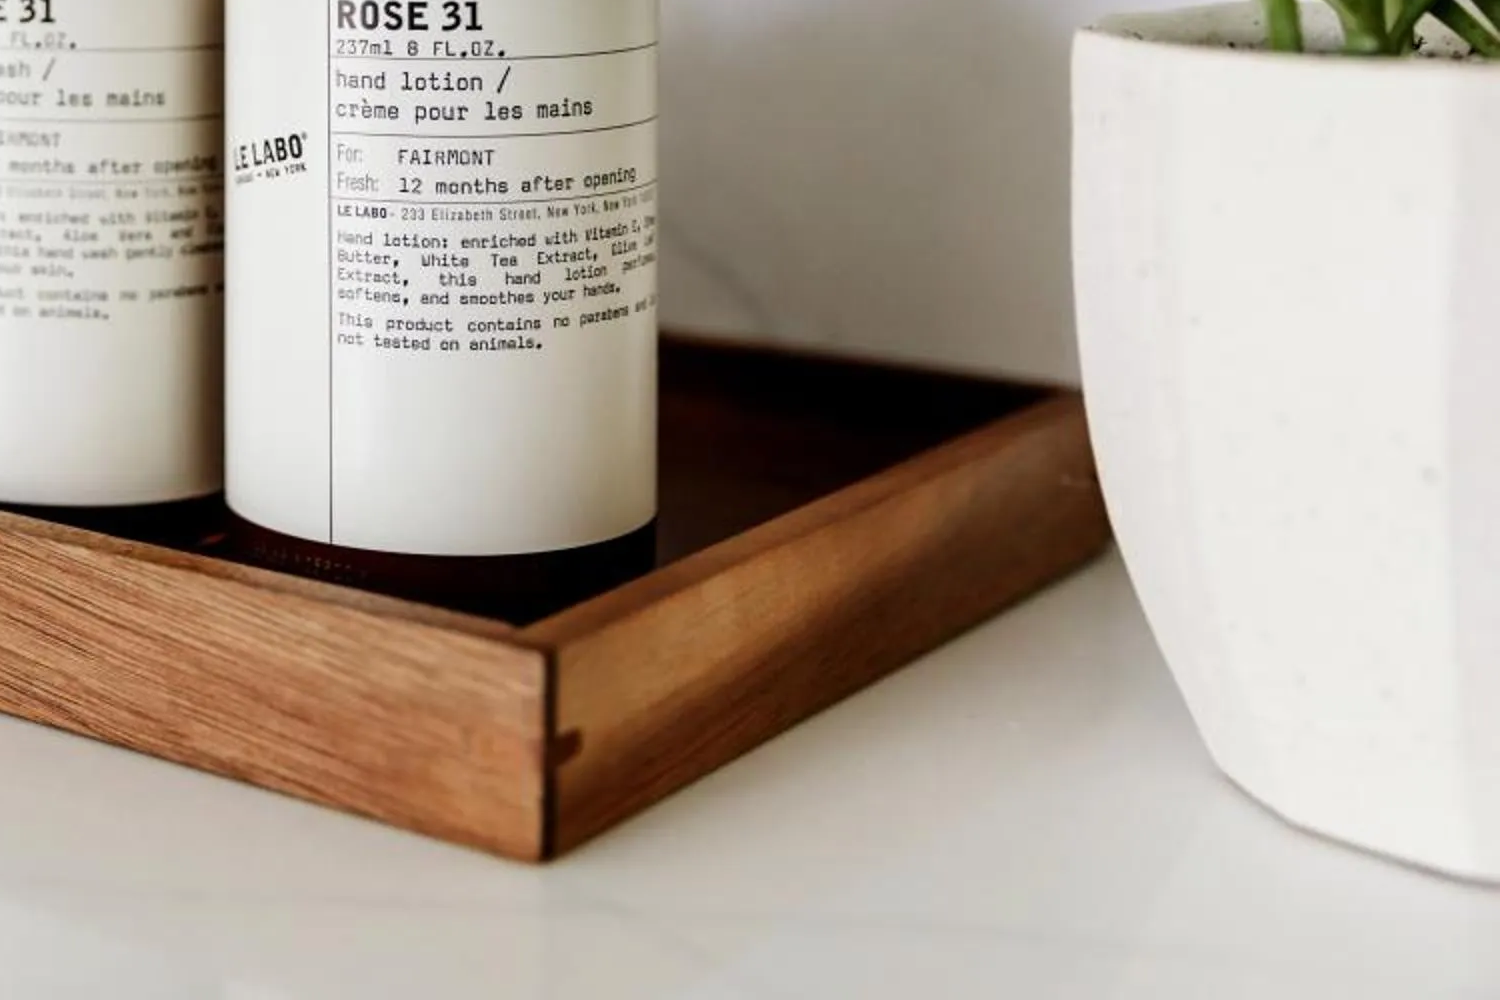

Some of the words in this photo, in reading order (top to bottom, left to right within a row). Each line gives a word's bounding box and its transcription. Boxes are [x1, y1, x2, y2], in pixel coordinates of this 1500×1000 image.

[337, 0, 429, 31] ROSE
[441, 2, 483, 31] 31
[336, 39, 393, 55] 237ml
[407, 40, 419, 57] 8
[433, 41, 505, 57] FL.OZ.
[42, 57, 56, 81] /
[336, 69, 386, 90] hand
[401, 71, 483, 91] lotion
[497, 65, 511, 94] /
[56, 88, 93, 107] les
[106, 89, 166, 107] mains
[335, 99, 399, 120] crème
[415, 104, 469, 125] pour
[484, 101, 523, 120] les
[537, 97, 593, 119] mains
[9, 157, 75, 174] months
[88, 158, 143, 174] after
[398, 149, 495, 166] FAIRMONT
[337, 171, 380, 192] Fresh:
[399, 177, 422, 194] 12
[435, 178, 508, 195] months
[521, 175, 575, 193] after
[583, 167, 637, 190] opening
[337, 205, 352, 217] LE
[355, 205, 387, 219] LABO
[401, 207, 425, 221] 233
[432, 208, 493, 221] Elizabeth
[547, 206, 569, 218] New
[383, 233, 448, 249] lotion:
[461, 233, 536, 249] enriched
[545, 230, 578, 245] with
[585, 223, 628, 242] Vitamin
[337, 249, 399, 268] Butter,
[421, 253, 469, 268] White
[490, 253, 518, 268] Tea
[537, 247, 598, 266] Extract,
[337, 267, 409, 288] Extract,
[439, 272, 477, 287] this
[505, 271, 541, 285] hand
[565, 264, 608, 281] lotion
[338, 287, 409, 306] softens,
[421, 292, 449, 305] and
[459, 290, 535, 305] smoothes
[543, 288, 576, 304] your
[338, 312, 373, 329] This
[386, 318, 454, 333] product
[467, 317, 542, 332] contains
[553, 315, 570, 329] no
[338, 333, 364, 347] not
[374, 334, 430, 351] tested
[440, 338, 459, 351] on
[469, 336, 542, 351] animals.
